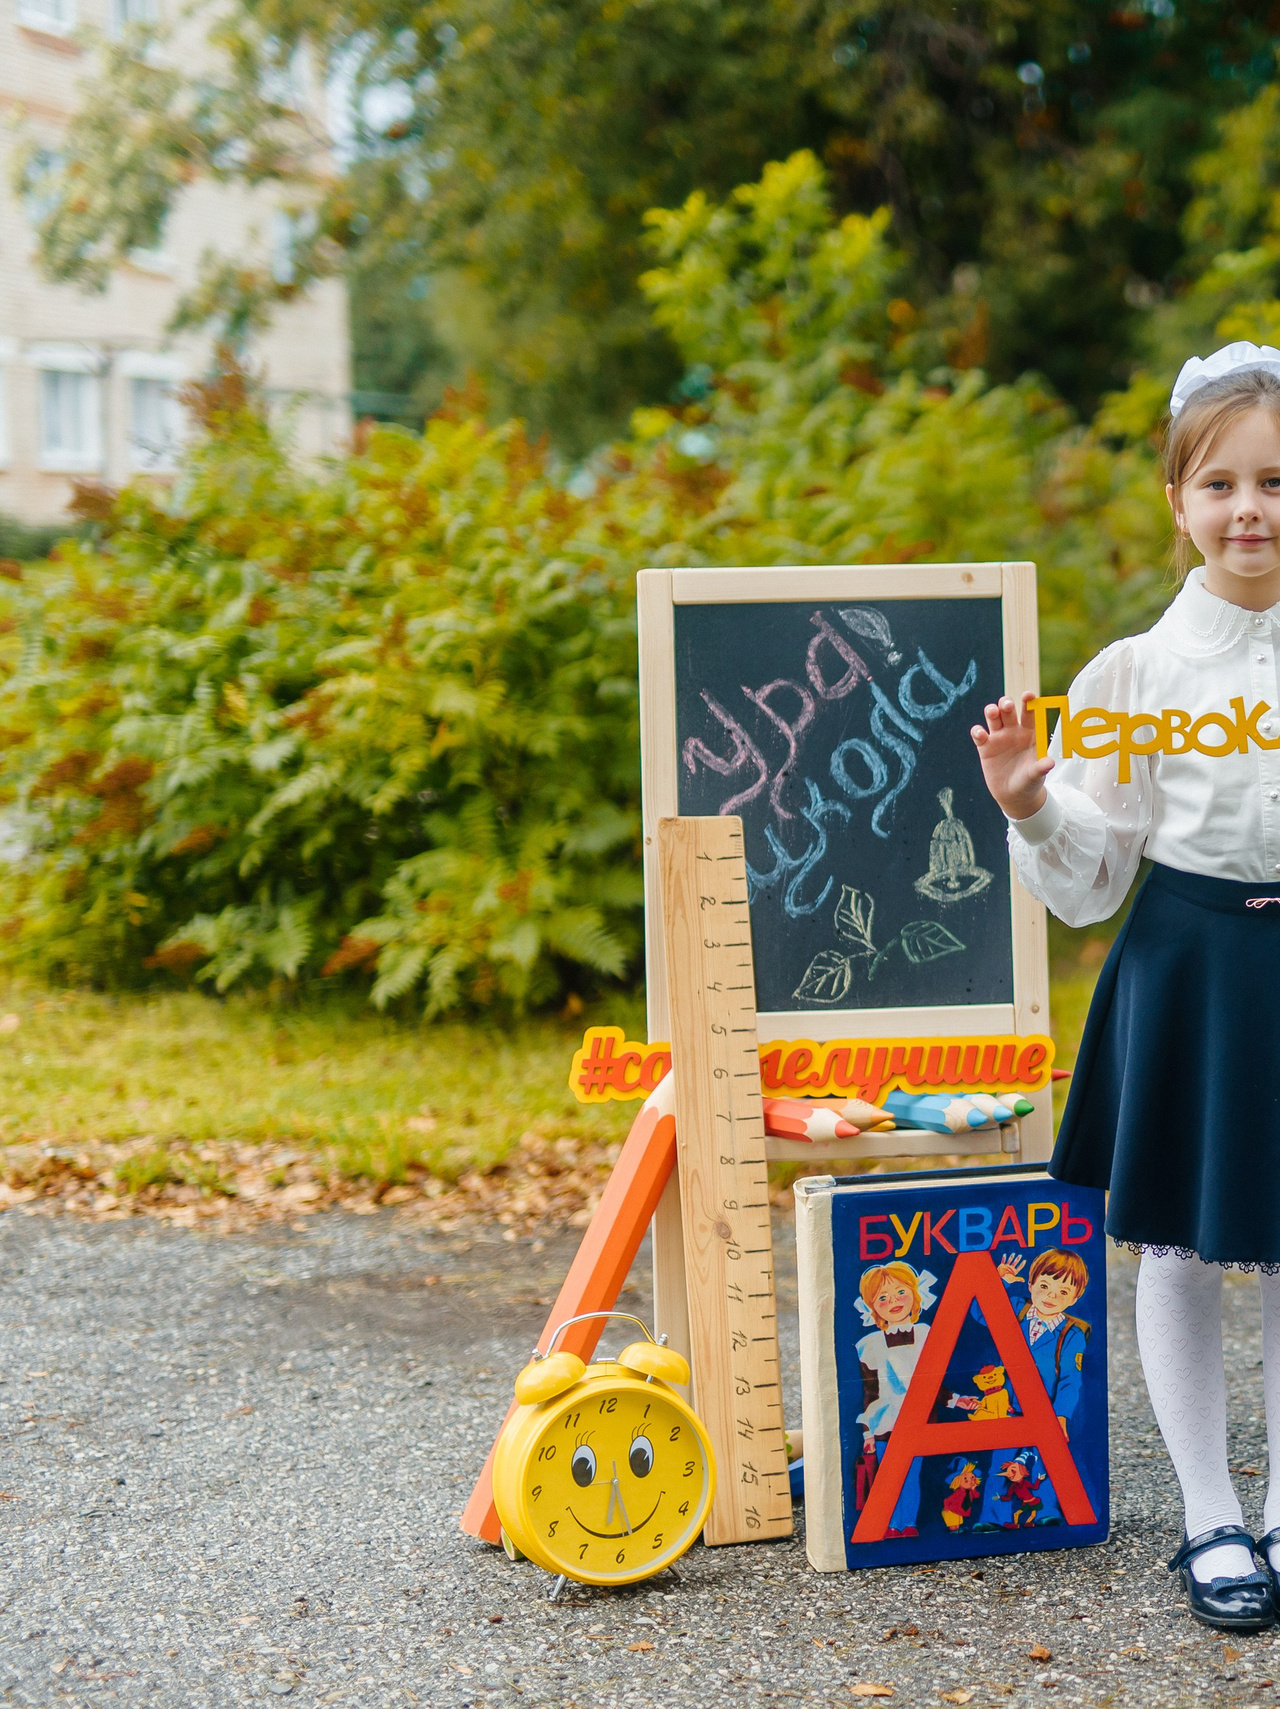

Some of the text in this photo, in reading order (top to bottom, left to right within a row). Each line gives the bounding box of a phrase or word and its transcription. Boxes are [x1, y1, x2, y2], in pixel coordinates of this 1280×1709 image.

[695, 851, 761, 1530] 1 2 3 4 5 6 7 8 9 10 11 12 13 14 15 16
[858, 1201, 1094, 1261] БУКВАРЬ
[599, 1397, 618, 1414] 12
[643, 1403, 651, 1419] 1
[564, 1412, 581, 1429] 11
[669, 1425, 681, 1442] 2
[538, 1444, 557, 1462] 10
[682, 1460, 696, 1478] 3
[531, 1485, 543, 1502] 9
[678, 1500, 690, 1517] 4
[547, 1520, 560, 1538] 8
[651, 1532, 664, 1550] 5
[578, 1543, 589, 1560] 7
[615, 1548, 625, 1564] 6
